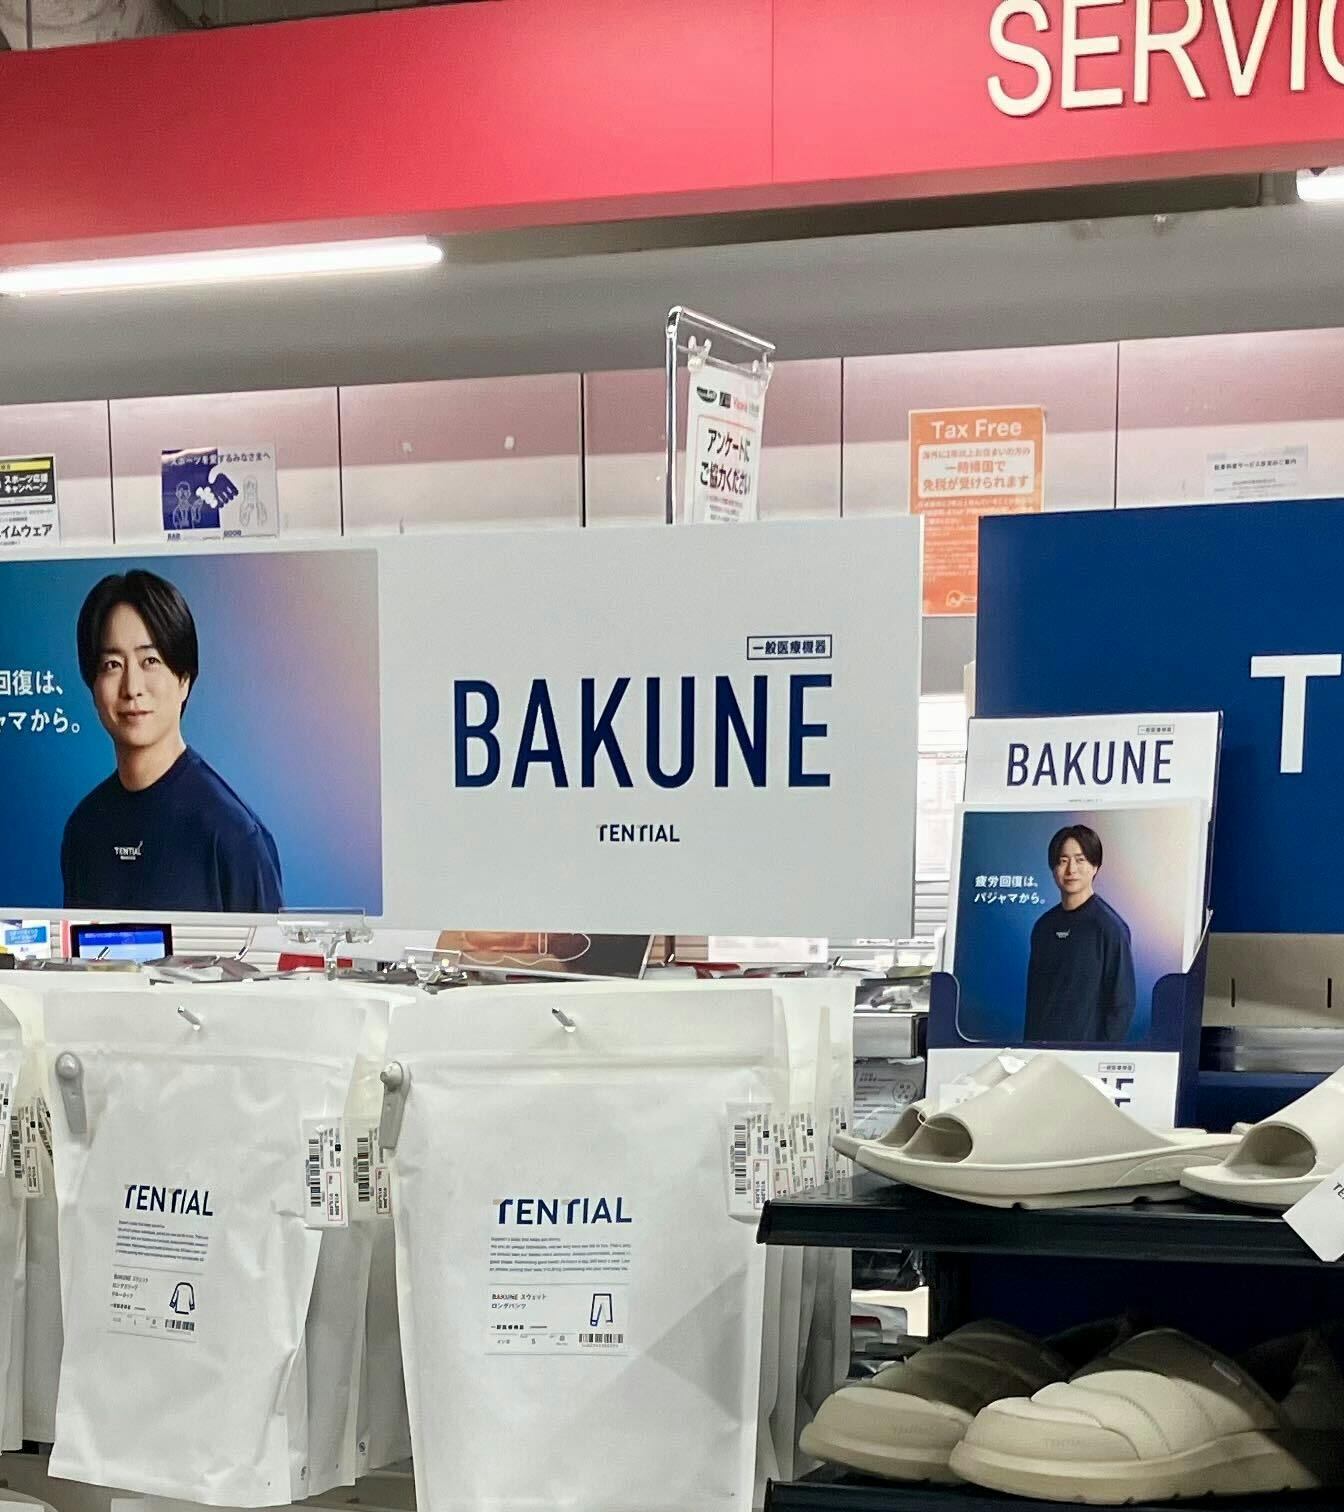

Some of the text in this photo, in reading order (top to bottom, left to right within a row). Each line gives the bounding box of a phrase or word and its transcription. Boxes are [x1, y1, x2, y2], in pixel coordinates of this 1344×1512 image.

[931, 418, 1021, 440] Tax Free
[751, 638, 827, 656] 一般医療機器
[453, 673, 833, 788] BAKUNE
[1006, 739, 1174, 787] BAKUNE
[597, 823, 680, 843] TENTIAL
[974, 874, 1039, 889] 疲労回復は、
[973, 891, 1046, 906] パジャマから。
[123, 1183, 214, 1217] TENTIAL
[494, 1197, 632, 1226] TENTIAL
